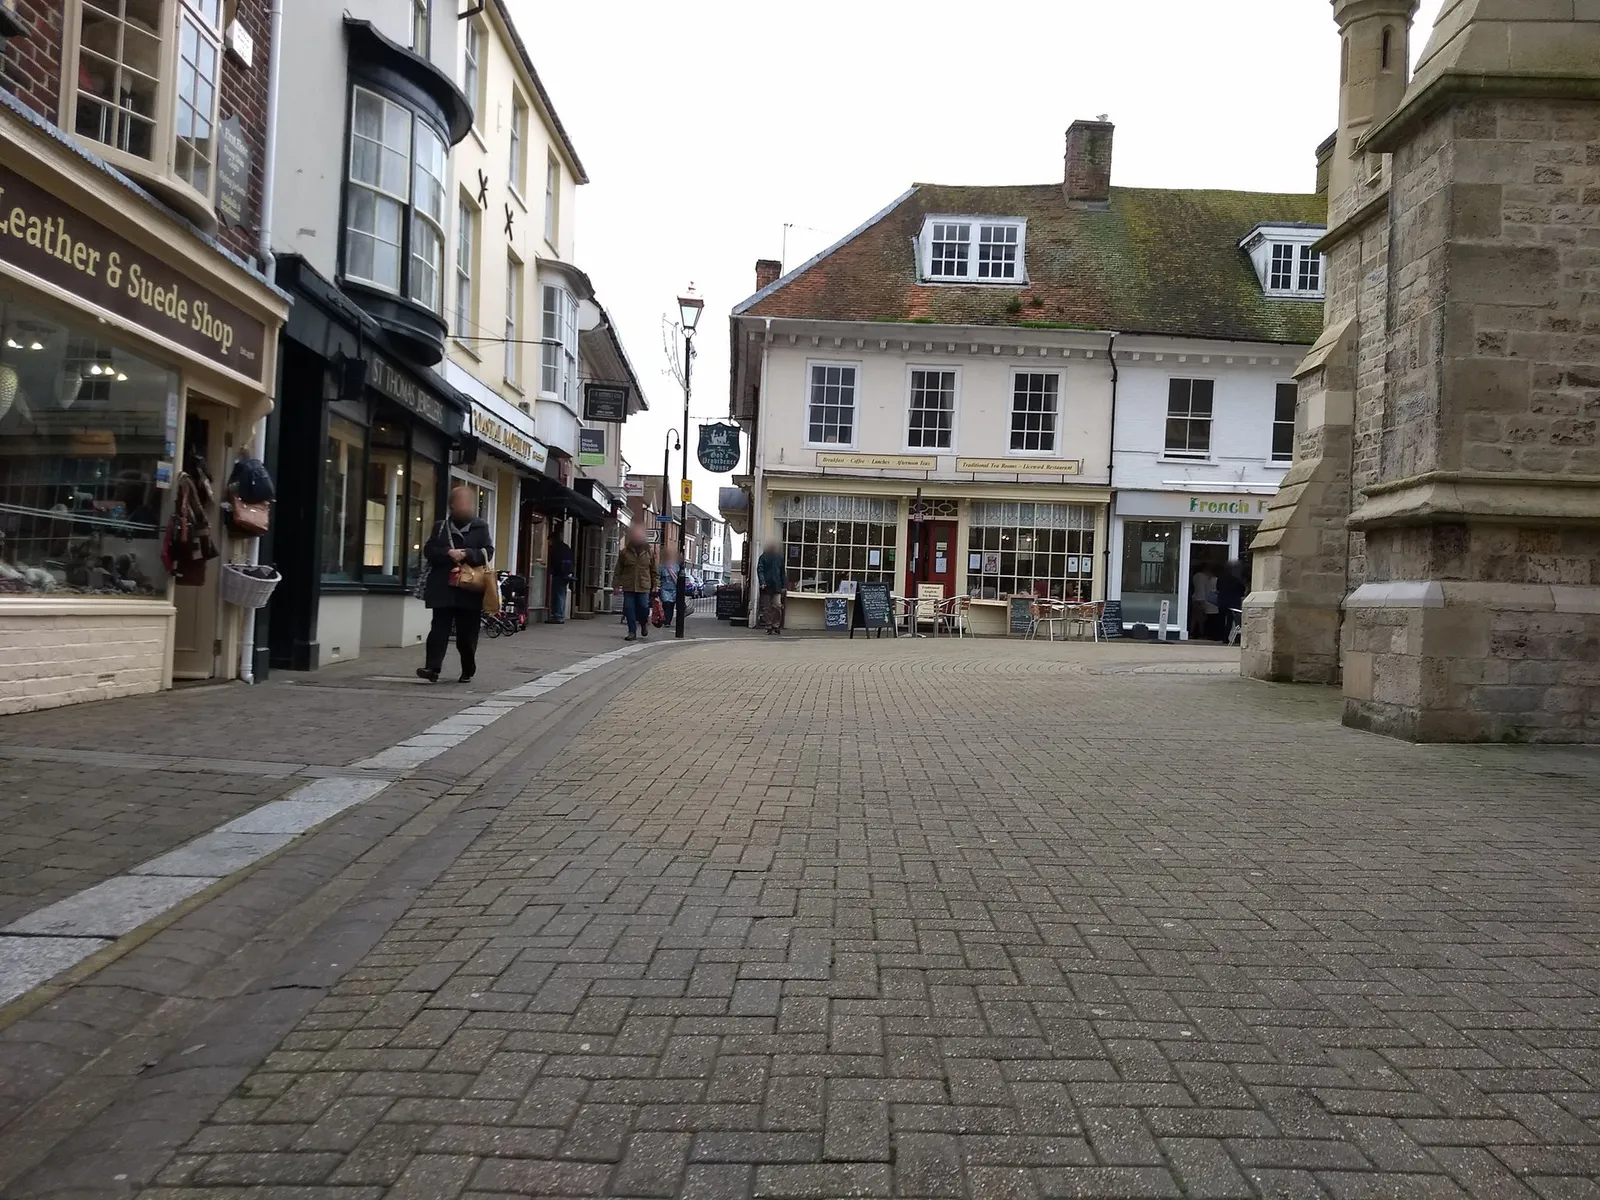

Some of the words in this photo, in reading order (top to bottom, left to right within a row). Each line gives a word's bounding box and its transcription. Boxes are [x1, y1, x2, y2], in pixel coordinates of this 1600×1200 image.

[107, 252, 122, 288] &
[127, 264, 188, 323] Suede
[192, 300, 233, 355] Shop
[1189, 497, 1250, 514] French
